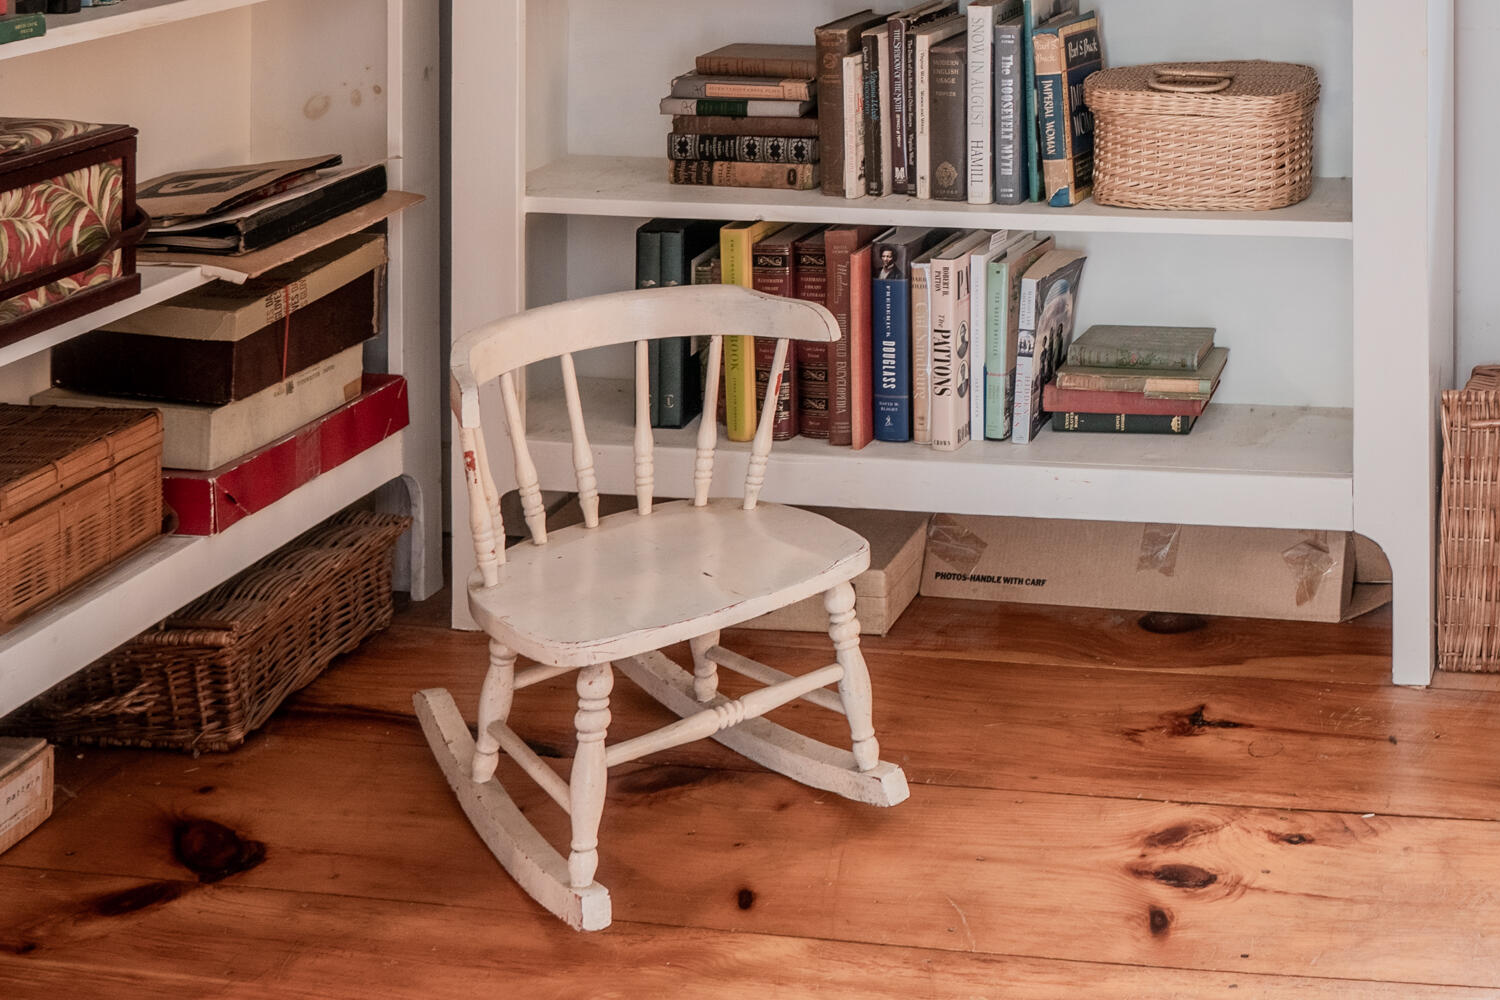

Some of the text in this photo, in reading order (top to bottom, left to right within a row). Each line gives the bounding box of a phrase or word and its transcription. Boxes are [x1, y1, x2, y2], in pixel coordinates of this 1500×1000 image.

[893, 29, 901, 41] THE
[1068, 41, 1079, 63] Pearl
[1083, 37, 1098, 57] Buck
[870, 70, 878, 99] Virginia
[970, 17, 985, 187] SNOW IN AUGUST HAMILL
[1000, 54, 1014, 177] The ROOSEVELT MYTH
[1041, 79, 1057, 155] IMPERIAL WOMAN
[1073, 111, 1092, 137] WOM
[835, 262, 848, 298] Modern
[934, 270, 942, 293] PATTON
[942, 266, 950, 289] ROBERT
[881, 339, 897, 390] DOUGLASS
[933, 315, 952, 397] The PATTONS
[835, 361, 847, 415] ENCYCLOPEDIA
[1002, 576, 1024, 586] WITH
